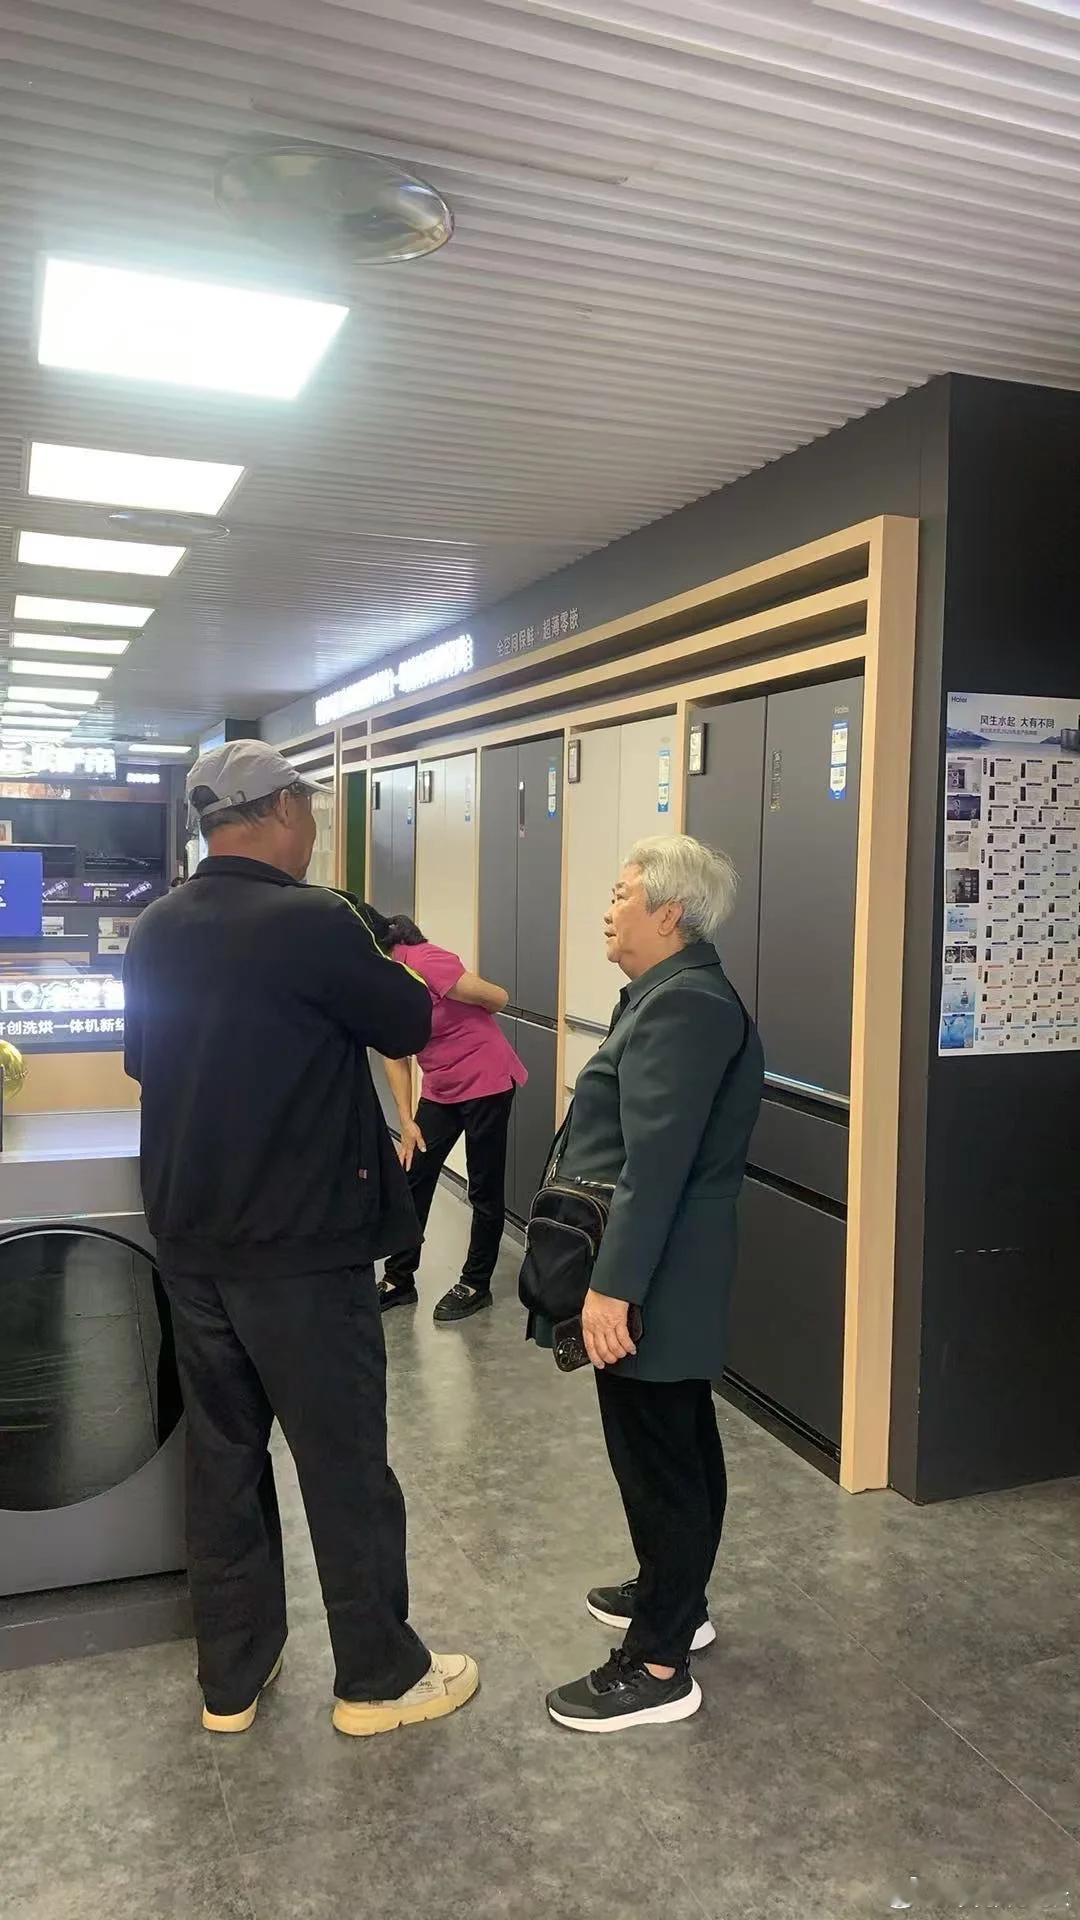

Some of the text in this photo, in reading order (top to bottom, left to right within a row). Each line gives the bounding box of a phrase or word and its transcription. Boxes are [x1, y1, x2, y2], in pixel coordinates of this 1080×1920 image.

[980, 715, 1055, 728] 风生水起 大有不同
